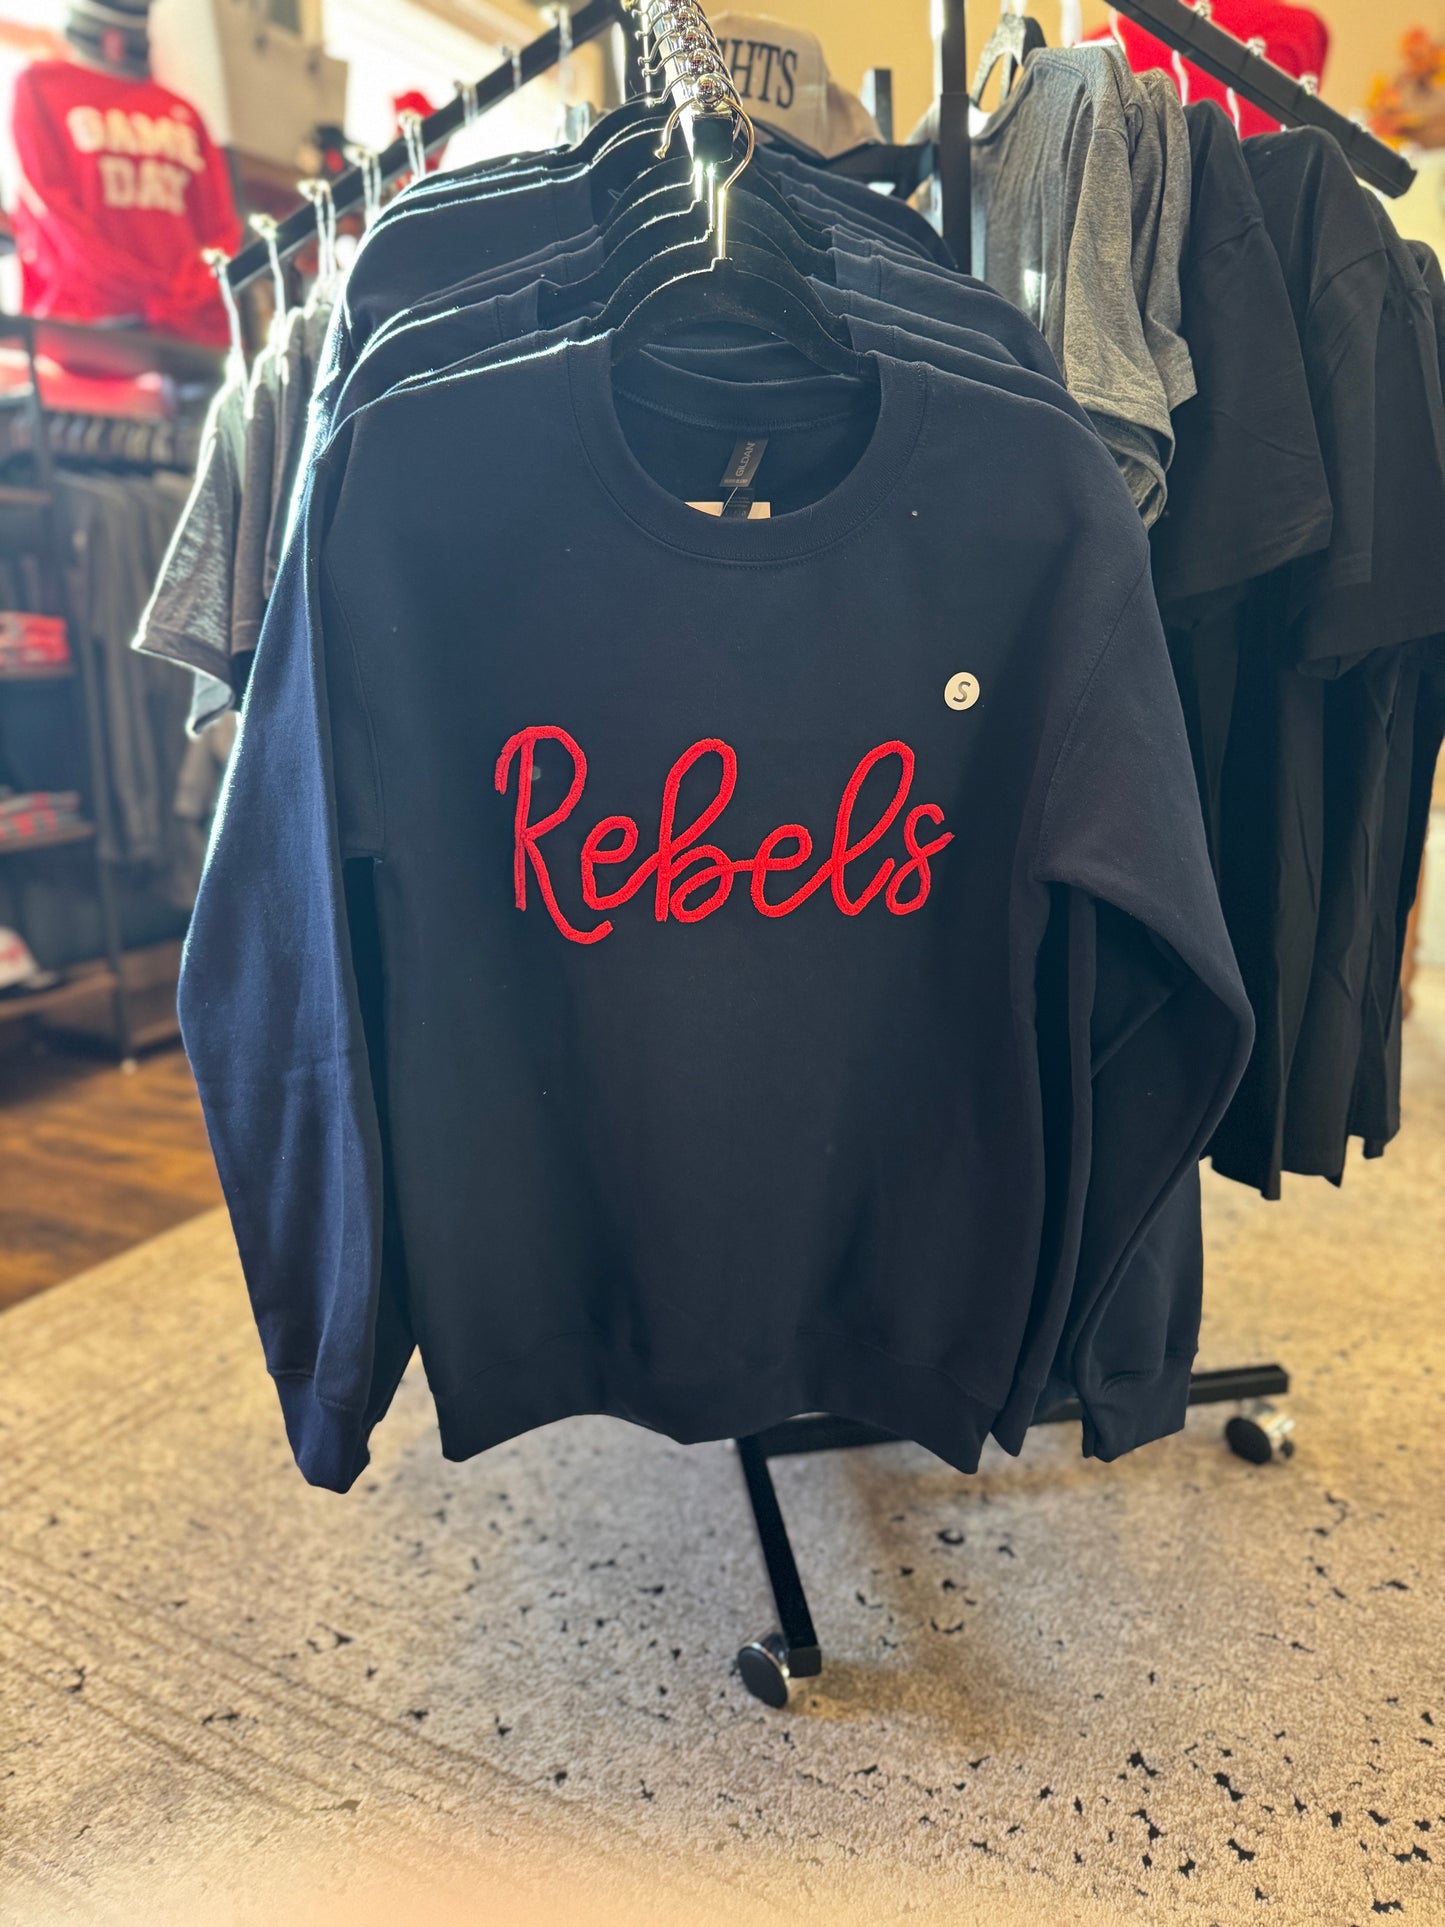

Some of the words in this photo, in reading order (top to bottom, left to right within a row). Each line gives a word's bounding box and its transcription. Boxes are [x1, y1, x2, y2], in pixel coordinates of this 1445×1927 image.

[66, 105, 205, 174] GAME
[97, 156, 191, 216] DAY
[735, 442, 755, 477] GILDAN
[952, 681, 971, 703] S
[495, 725, 956, 945] Rebels
